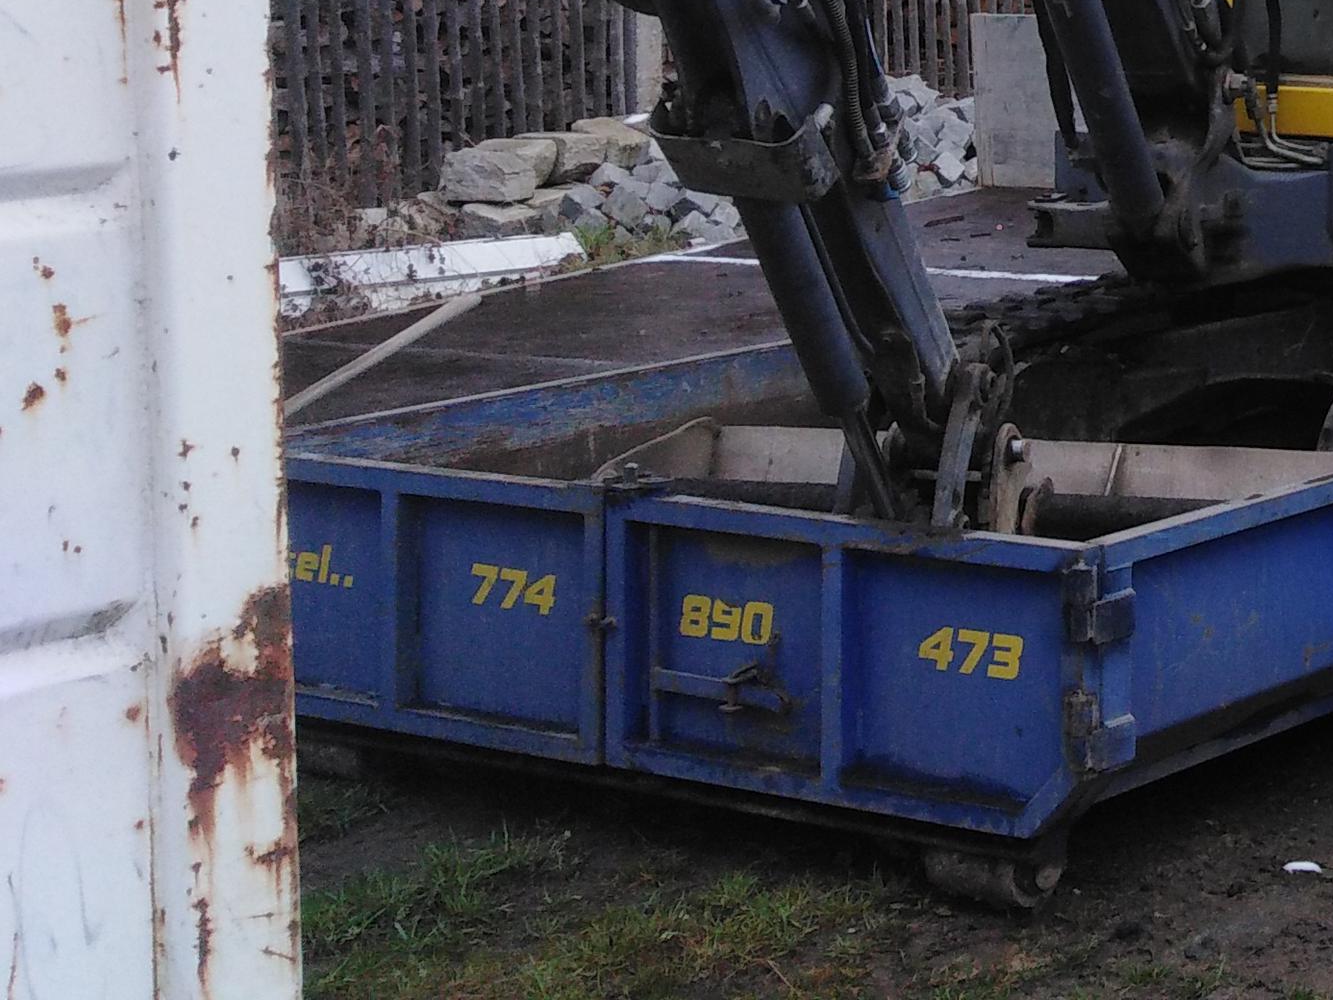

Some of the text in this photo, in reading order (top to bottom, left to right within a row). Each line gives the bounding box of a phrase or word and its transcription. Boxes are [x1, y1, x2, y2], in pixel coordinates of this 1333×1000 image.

[471, 562, 558, 616] 774
[679, 593, 774, 645] 890
[917, 626, 1024, 680] 473
